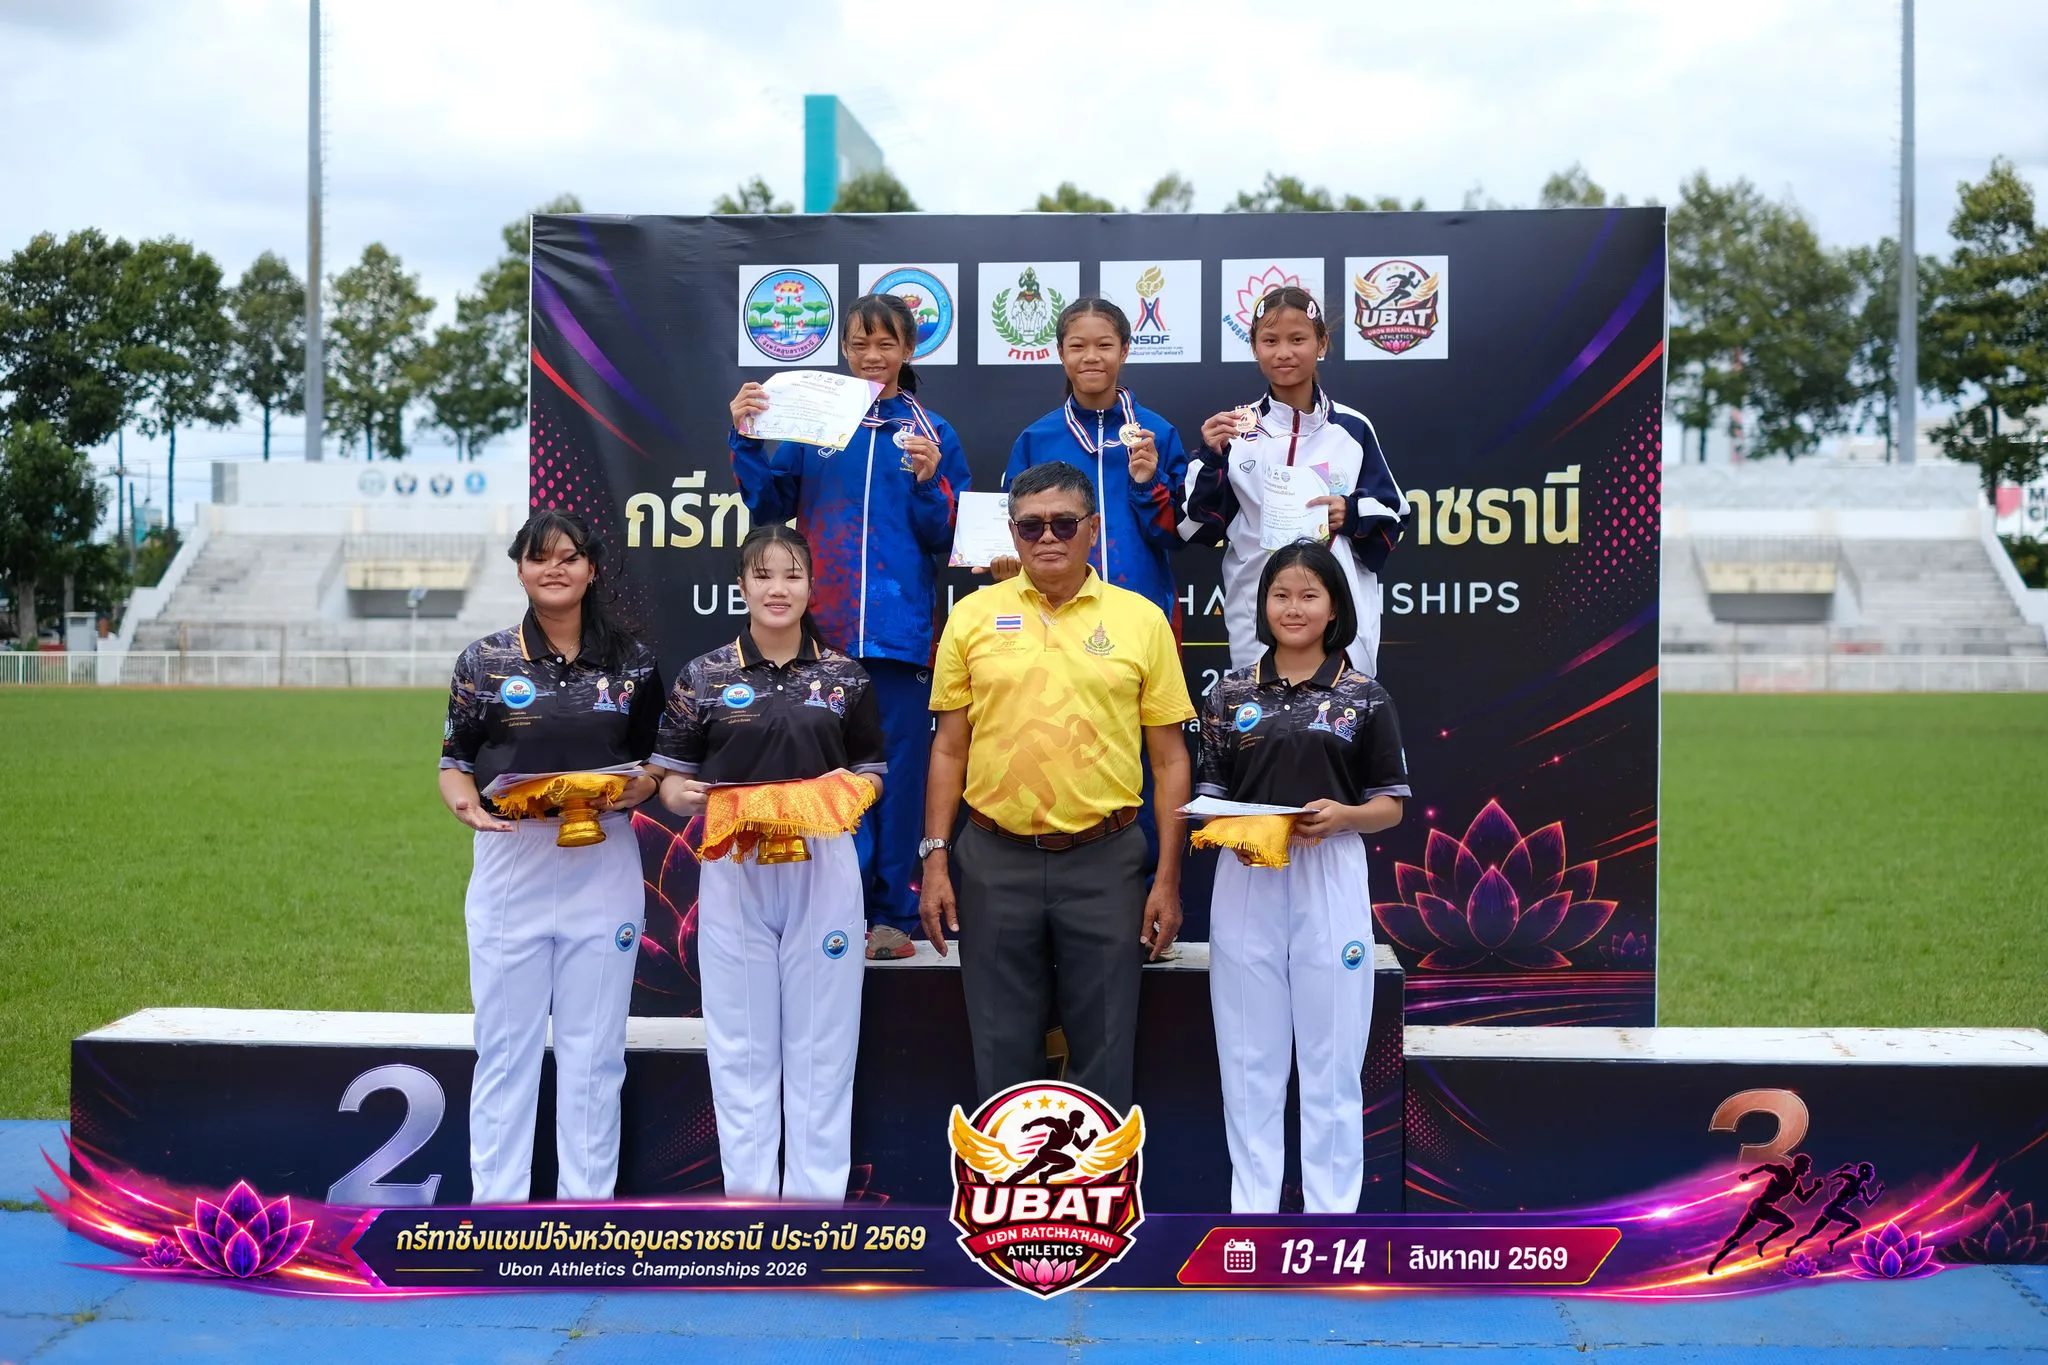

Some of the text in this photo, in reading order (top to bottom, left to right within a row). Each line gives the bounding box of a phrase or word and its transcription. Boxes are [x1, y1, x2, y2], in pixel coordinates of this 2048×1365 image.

[1361, 309, 1433, 328] UBAT
[1130, 334, 1170, 345] NSDF
[693, 584, 750, 615] UB
[325, 1063, 446, 1206] 2
